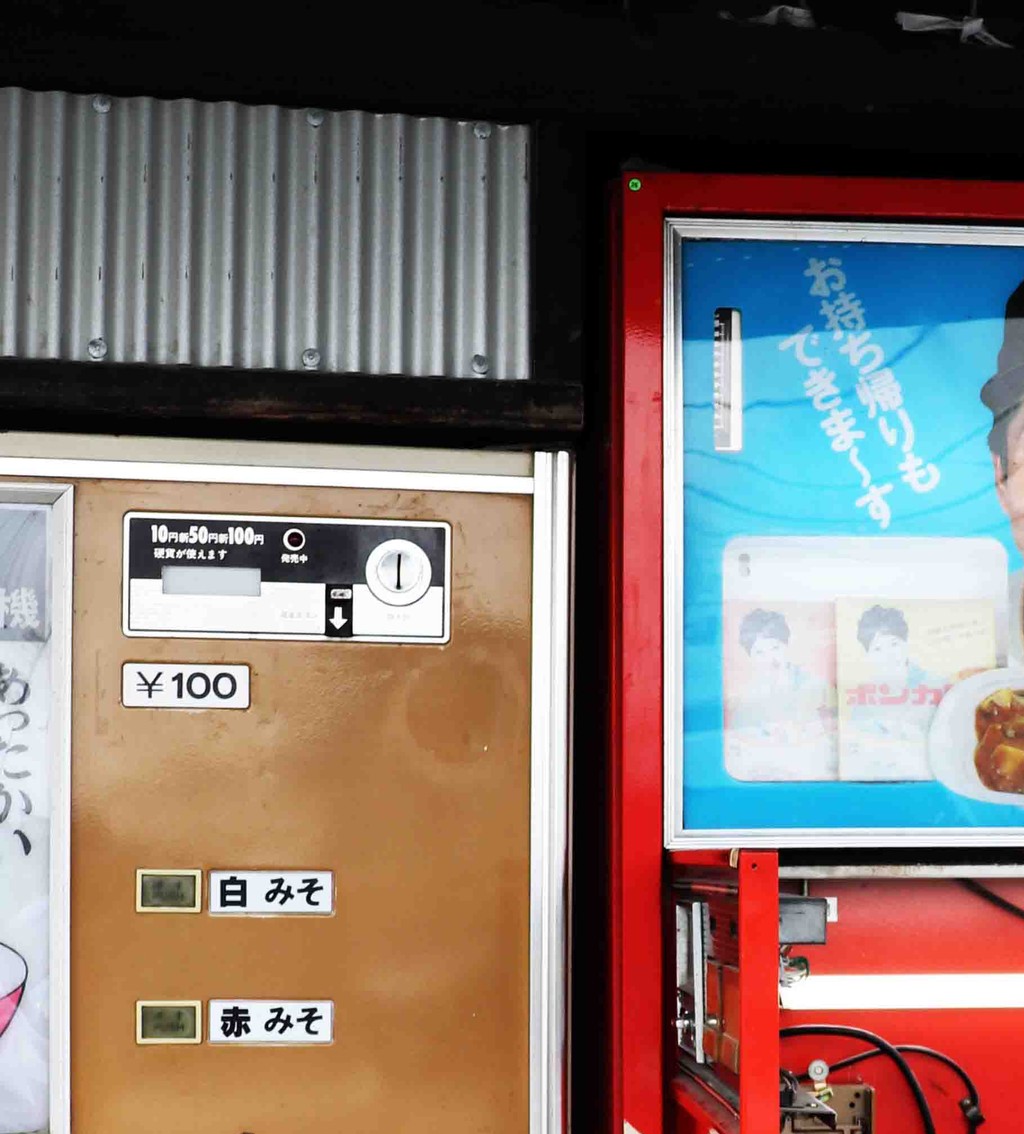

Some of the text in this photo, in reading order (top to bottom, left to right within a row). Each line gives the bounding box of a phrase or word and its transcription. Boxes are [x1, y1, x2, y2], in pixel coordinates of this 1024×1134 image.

[804, 257, 940, 493] お持ち帰りも
[0, 587, 40, 630] 機
[136, 671, 237, 699] ¥100
